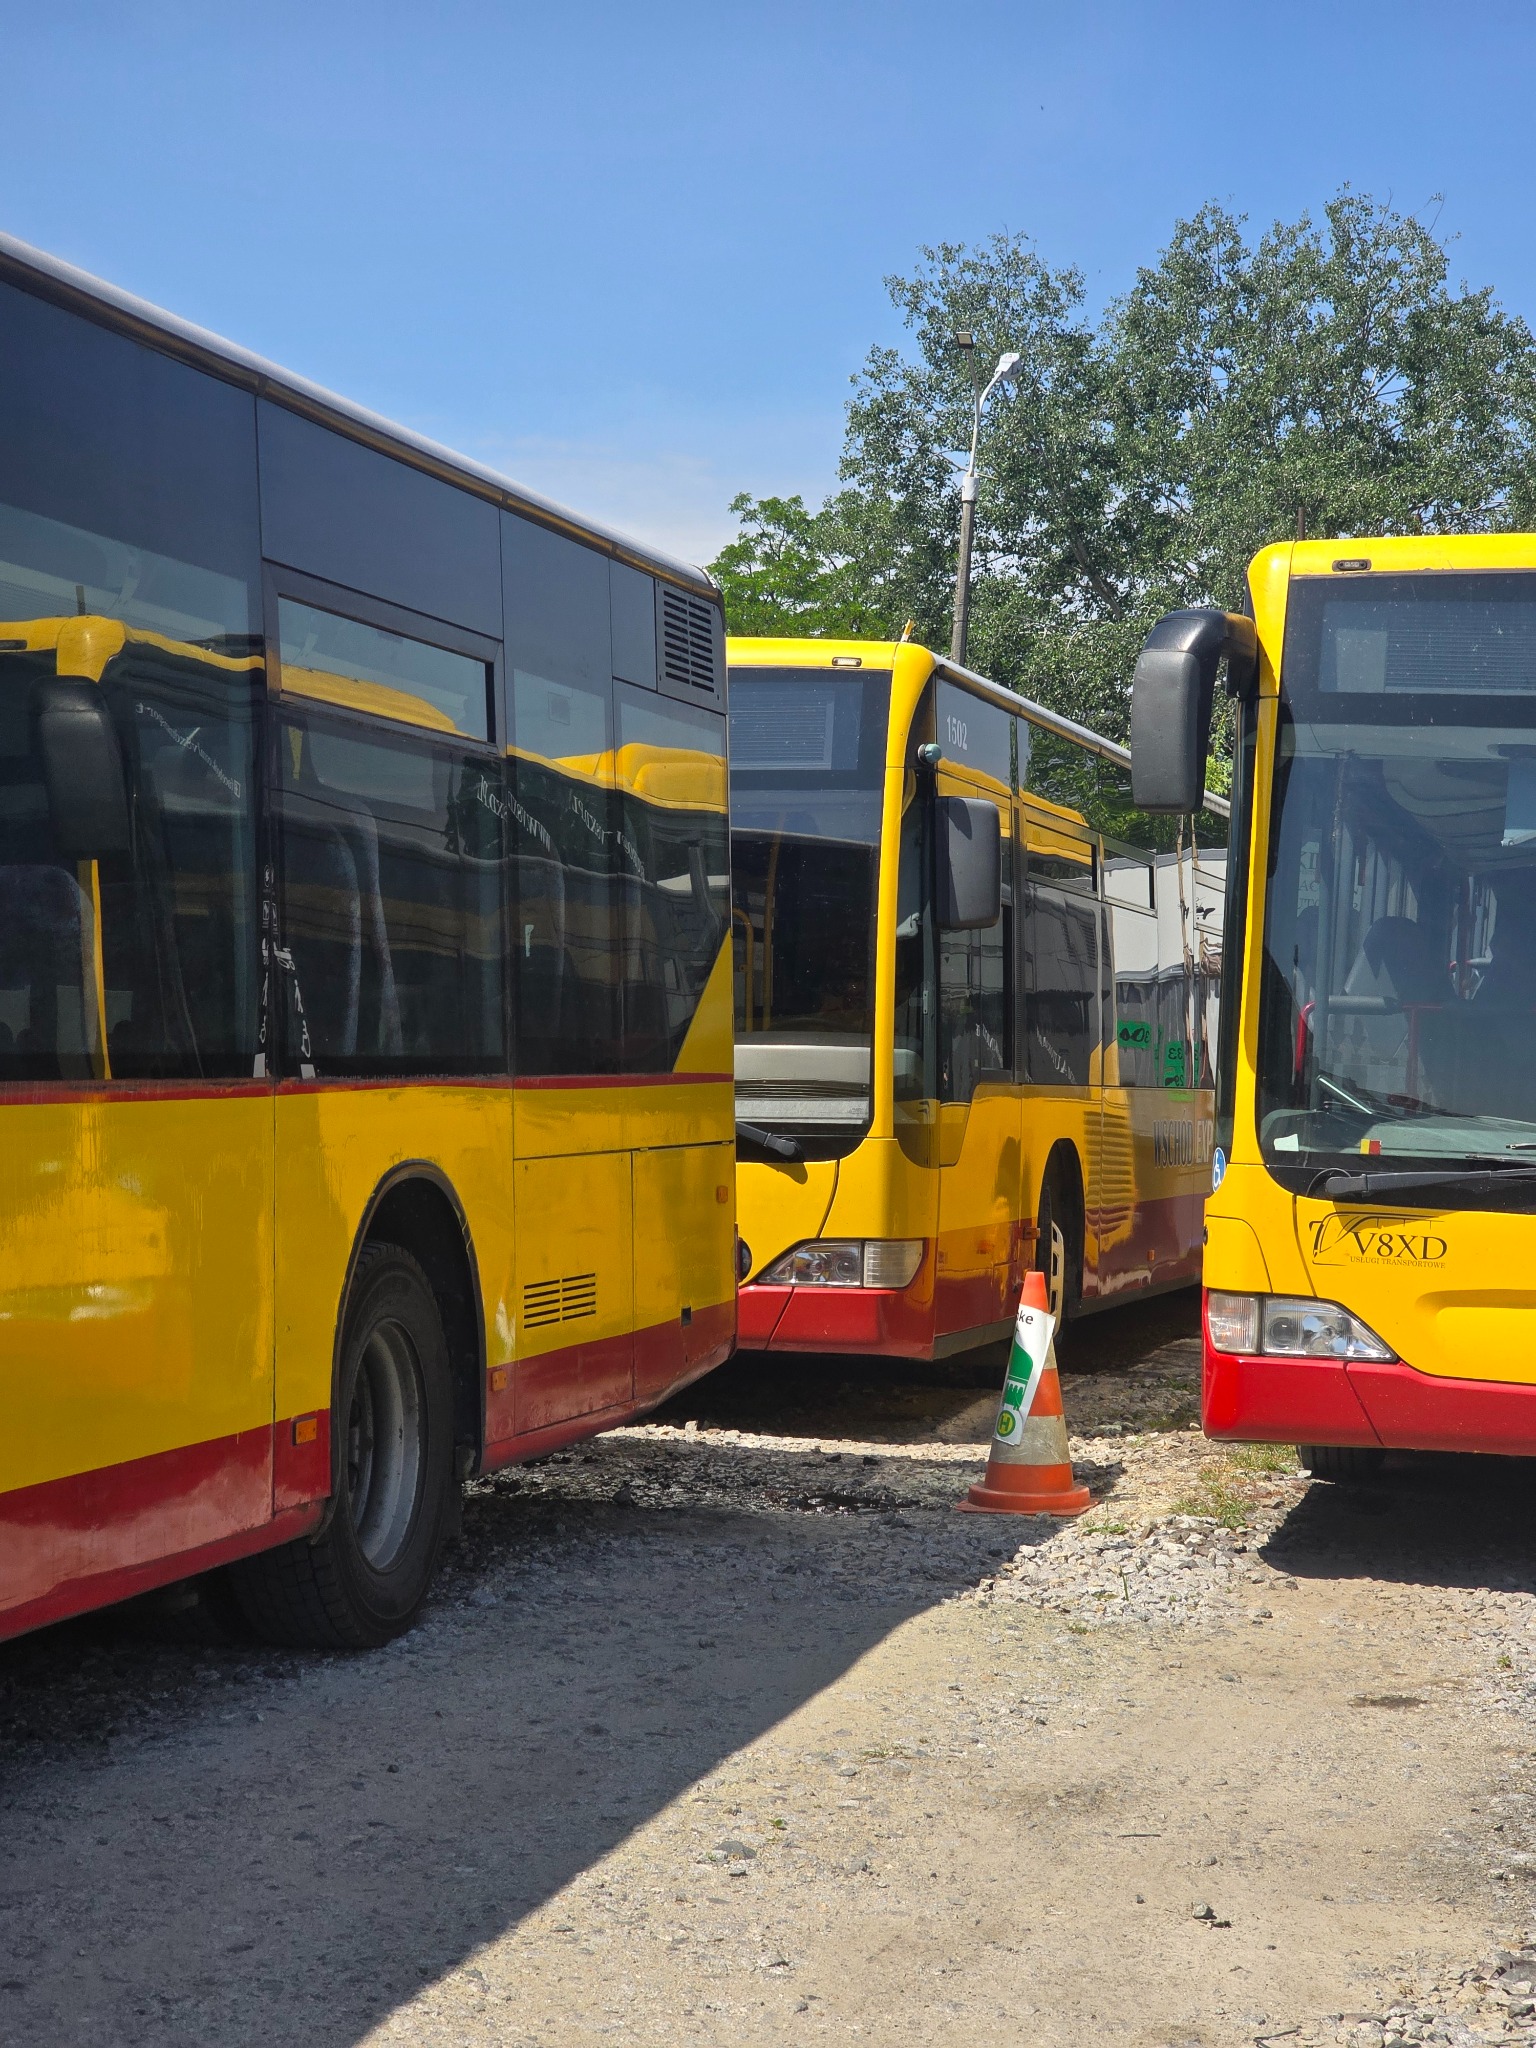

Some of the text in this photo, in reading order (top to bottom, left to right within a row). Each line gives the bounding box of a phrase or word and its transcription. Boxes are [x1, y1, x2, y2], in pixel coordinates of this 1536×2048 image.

[946, 714, 968, 751] 1502
[1350, 1231, 1448, 1260] V8XD
[1381, 1258, 1446, 1269] TRANSPORTOWE
[1016, 1310, 1034, 1325] ke
